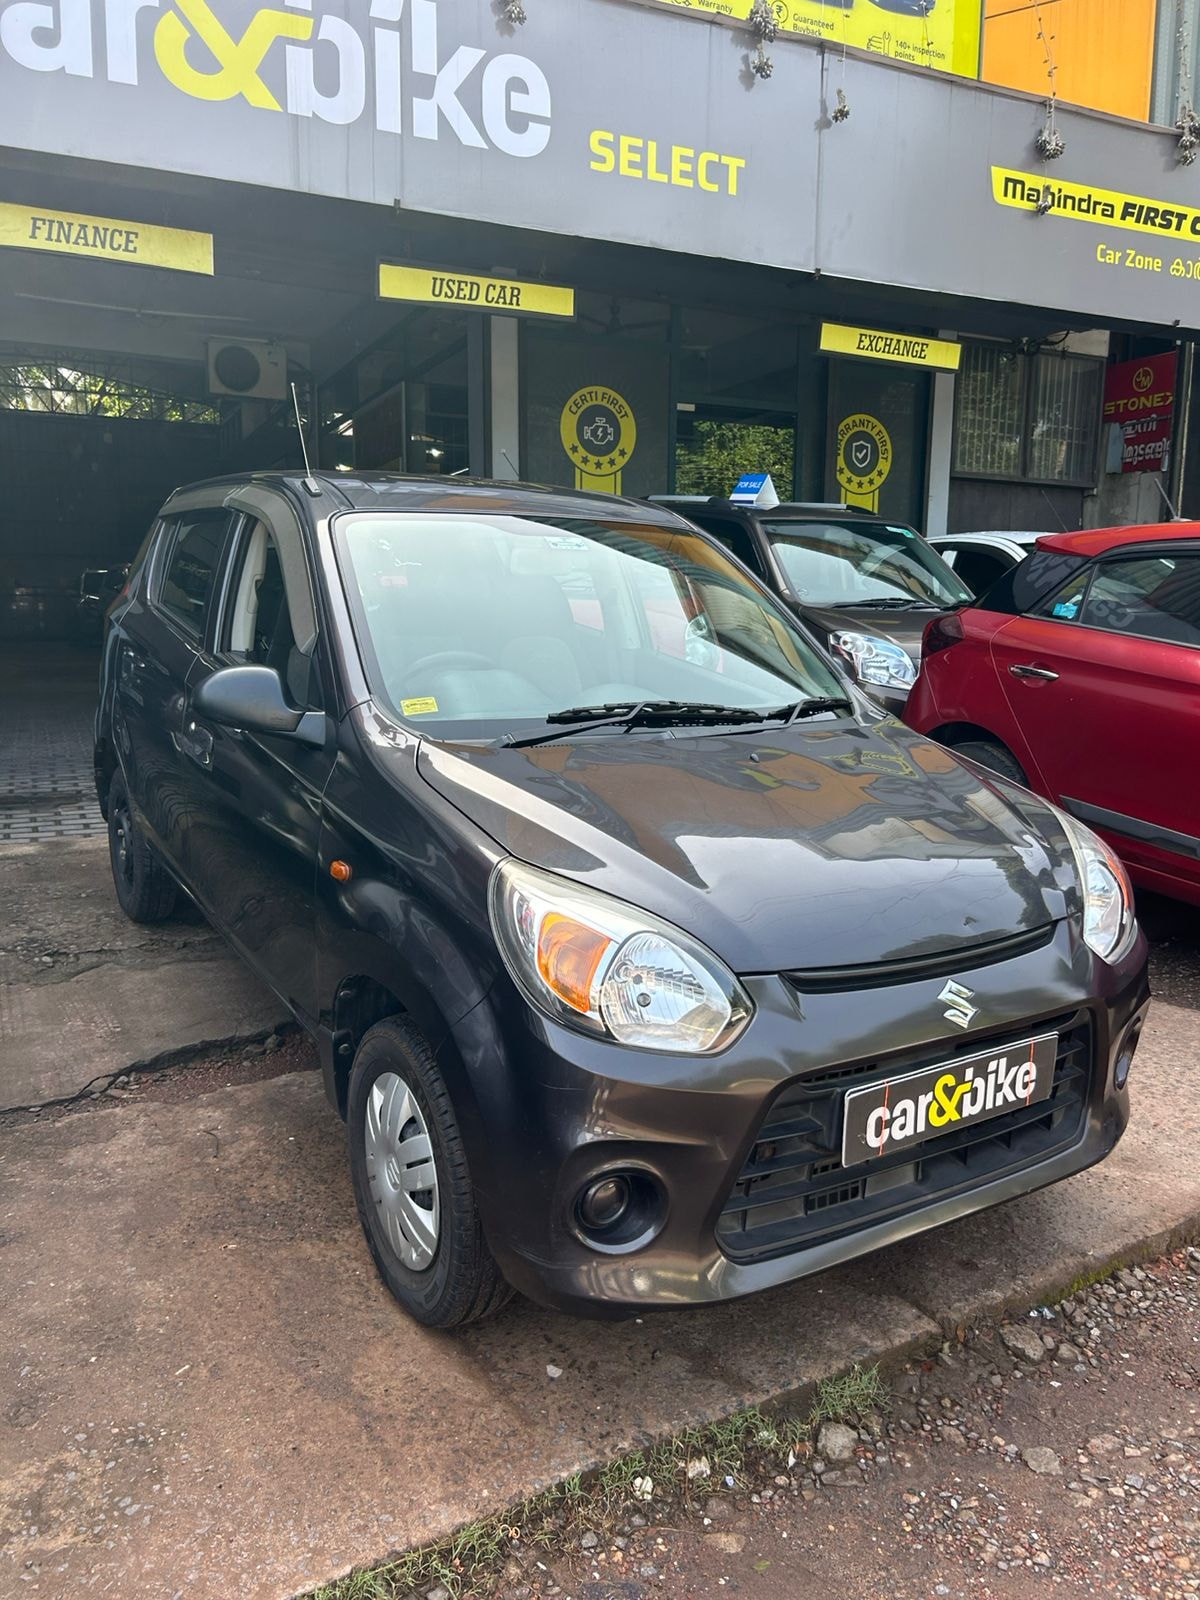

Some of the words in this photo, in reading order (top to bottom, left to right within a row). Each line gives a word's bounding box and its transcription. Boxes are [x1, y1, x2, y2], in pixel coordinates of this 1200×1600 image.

[793, 13, 834, 30] Guaranteed
[793, 23, 822, 36] Buyback
[894, 50, 915, 62] points
[895, 40, 911, 49] 140+
[912, 44, 945, 60] inspection
[590, 130, 745, 195] SELECT
[1120, 202, 1188, 231] FIRST
[29, 217, 139, 255] FINANCE
[1097, 244, 1122, 265] Car
[1125, 249, 1162, 272] Zone
[431, 276, 480, 302] USED
[485, 283, 521, 307] CAR
[857, 333, 929, 360] EXCHANGE
[568, 390, 598, 415] CERTI
[601, 391, 629, 420] FIRST
[875, 429, 889, 463] FIRST
[737, 481, 750, 489] FOR
[748, 481, 763, 489] SALE
[866, 1056, 1037, 1148] car&bike
